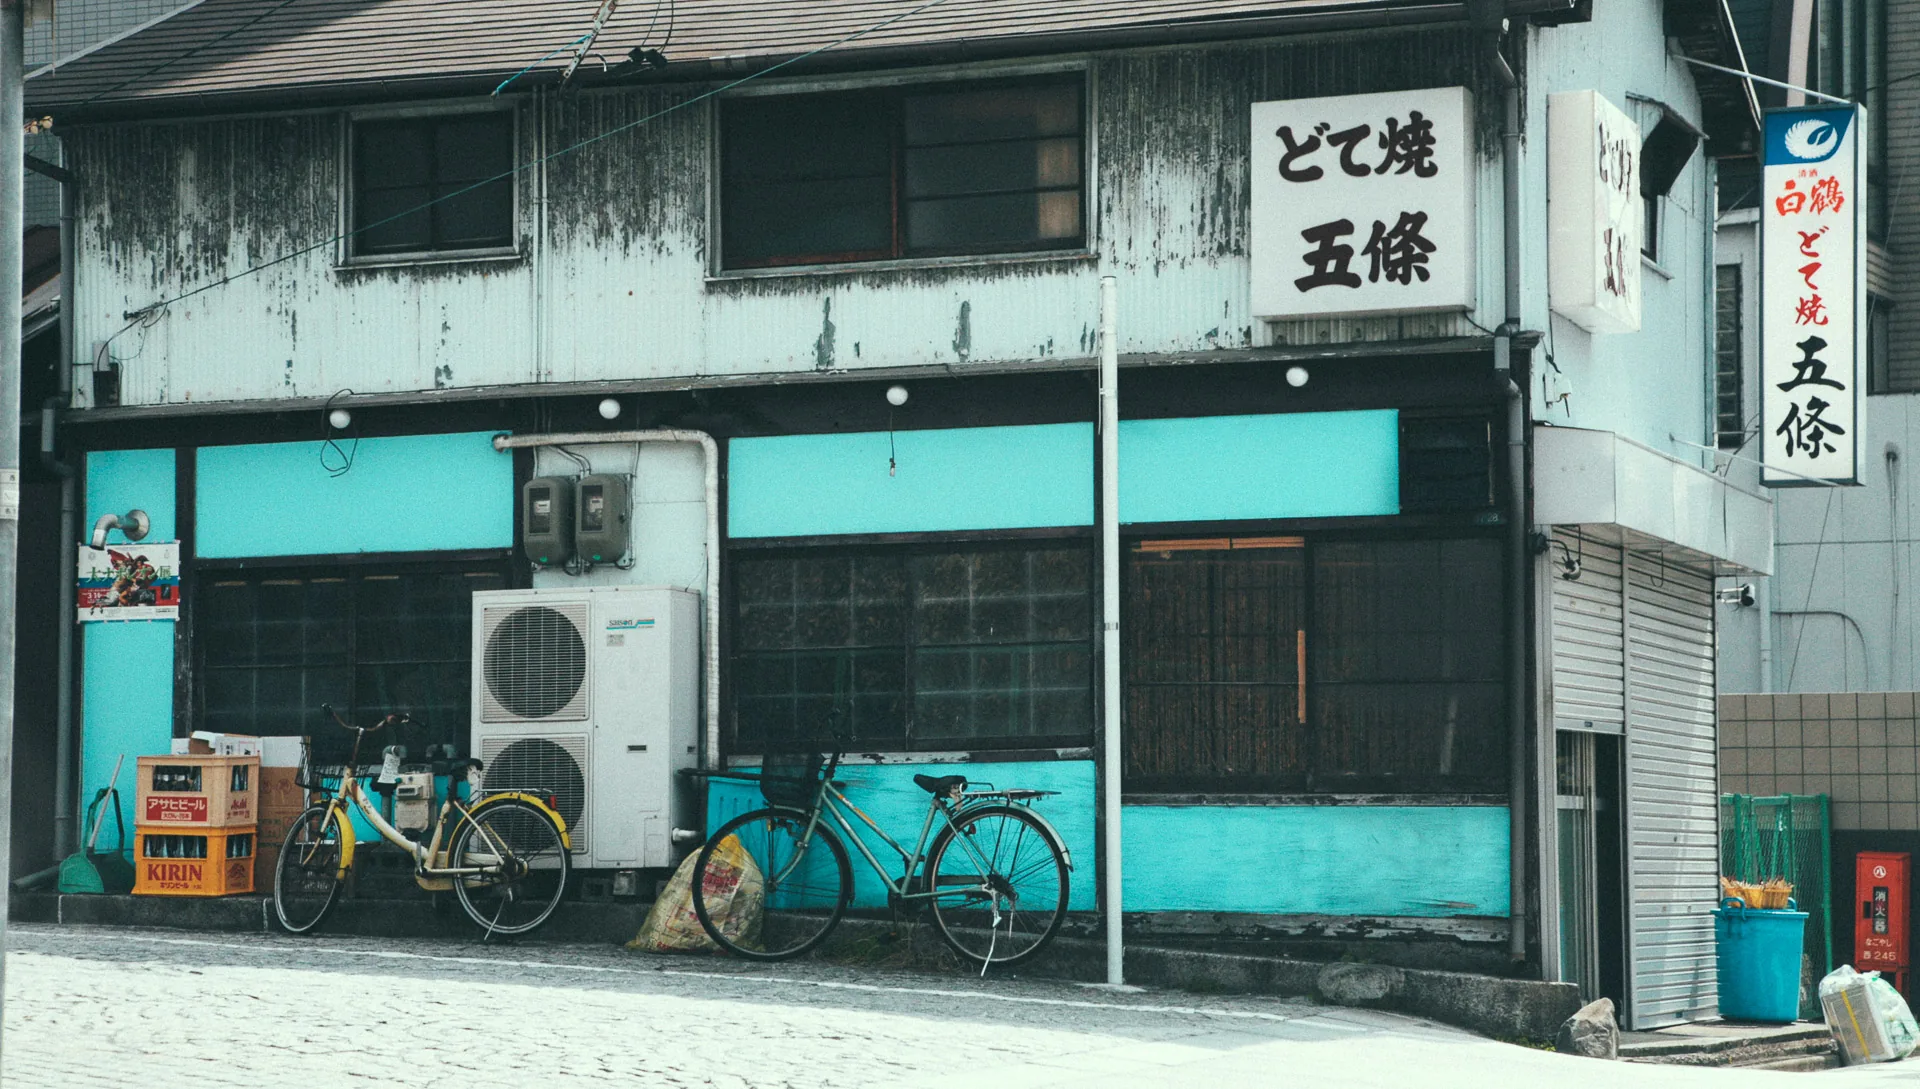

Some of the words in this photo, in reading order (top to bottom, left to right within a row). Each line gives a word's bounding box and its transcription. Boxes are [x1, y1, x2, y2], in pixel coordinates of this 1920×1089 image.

[1275, 110, 1439, 183] どて焼
[1775, 175, 1845, 216] 白鶴
[1294, 211, 1437, 293] 五條
[147, 798, 206, 811] アサヒビール
[147, 863, 203, 882] KIRIN
[1875, 891, 1886, 932] 消火器
[1865, 938, 1892, 947] なごやし
[1874, 951, 1896, 961] 245
